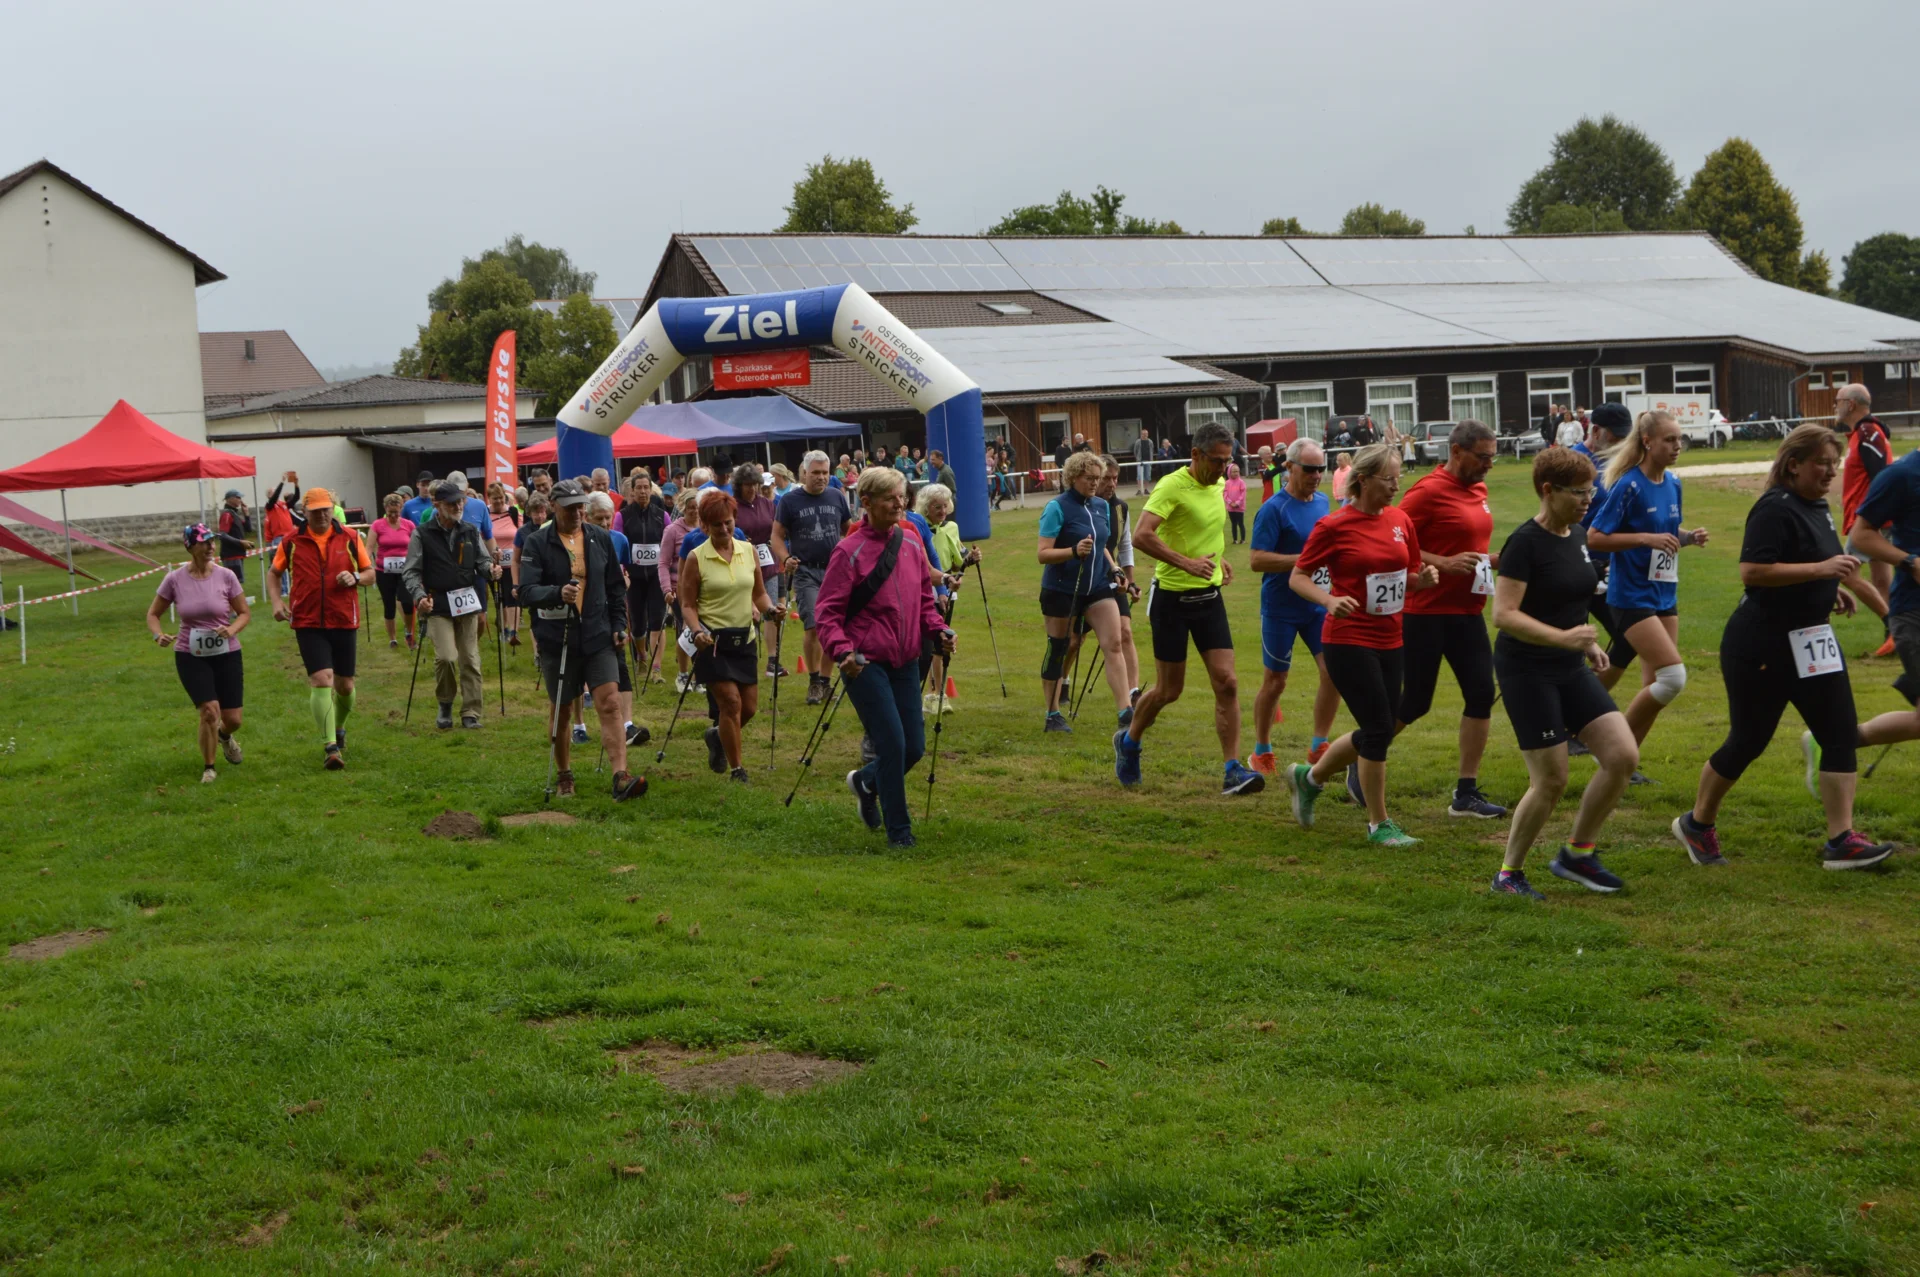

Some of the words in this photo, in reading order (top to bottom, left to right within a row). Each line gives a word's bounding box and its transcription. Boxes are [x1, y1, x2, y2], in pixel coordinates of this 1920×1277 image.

[703, 299, 800, 343] Ziel
[861, 328, 933, 389] INTERSPORT
[877, 325, 926, 366] OSTERODE
[589, 345, 629, 388] OSTERODE
[589, 338, 650, 404] INTERSPORT
[734, 364, 773, 374] Sparkasse
[734, 373, 769, 383] Osterode
[770, 373, 782, 381] am
[784, 371, 802, 379] Harz
[848, 336, 918, 399] STRICKER
[494, 348, 512, 448] Förste
[594, 352, 660, 419] STRICKER
[799, 507, 816, 518] NEW
[818, 505, 836, 515] YORK
[636, 550, 657, 560] 028
[454, 594, 476, 609] 073
[1375, 580, 1404, 604] 213
[196, 636, 224, 649] 106
[1803, 636, 1837, 661] 176
